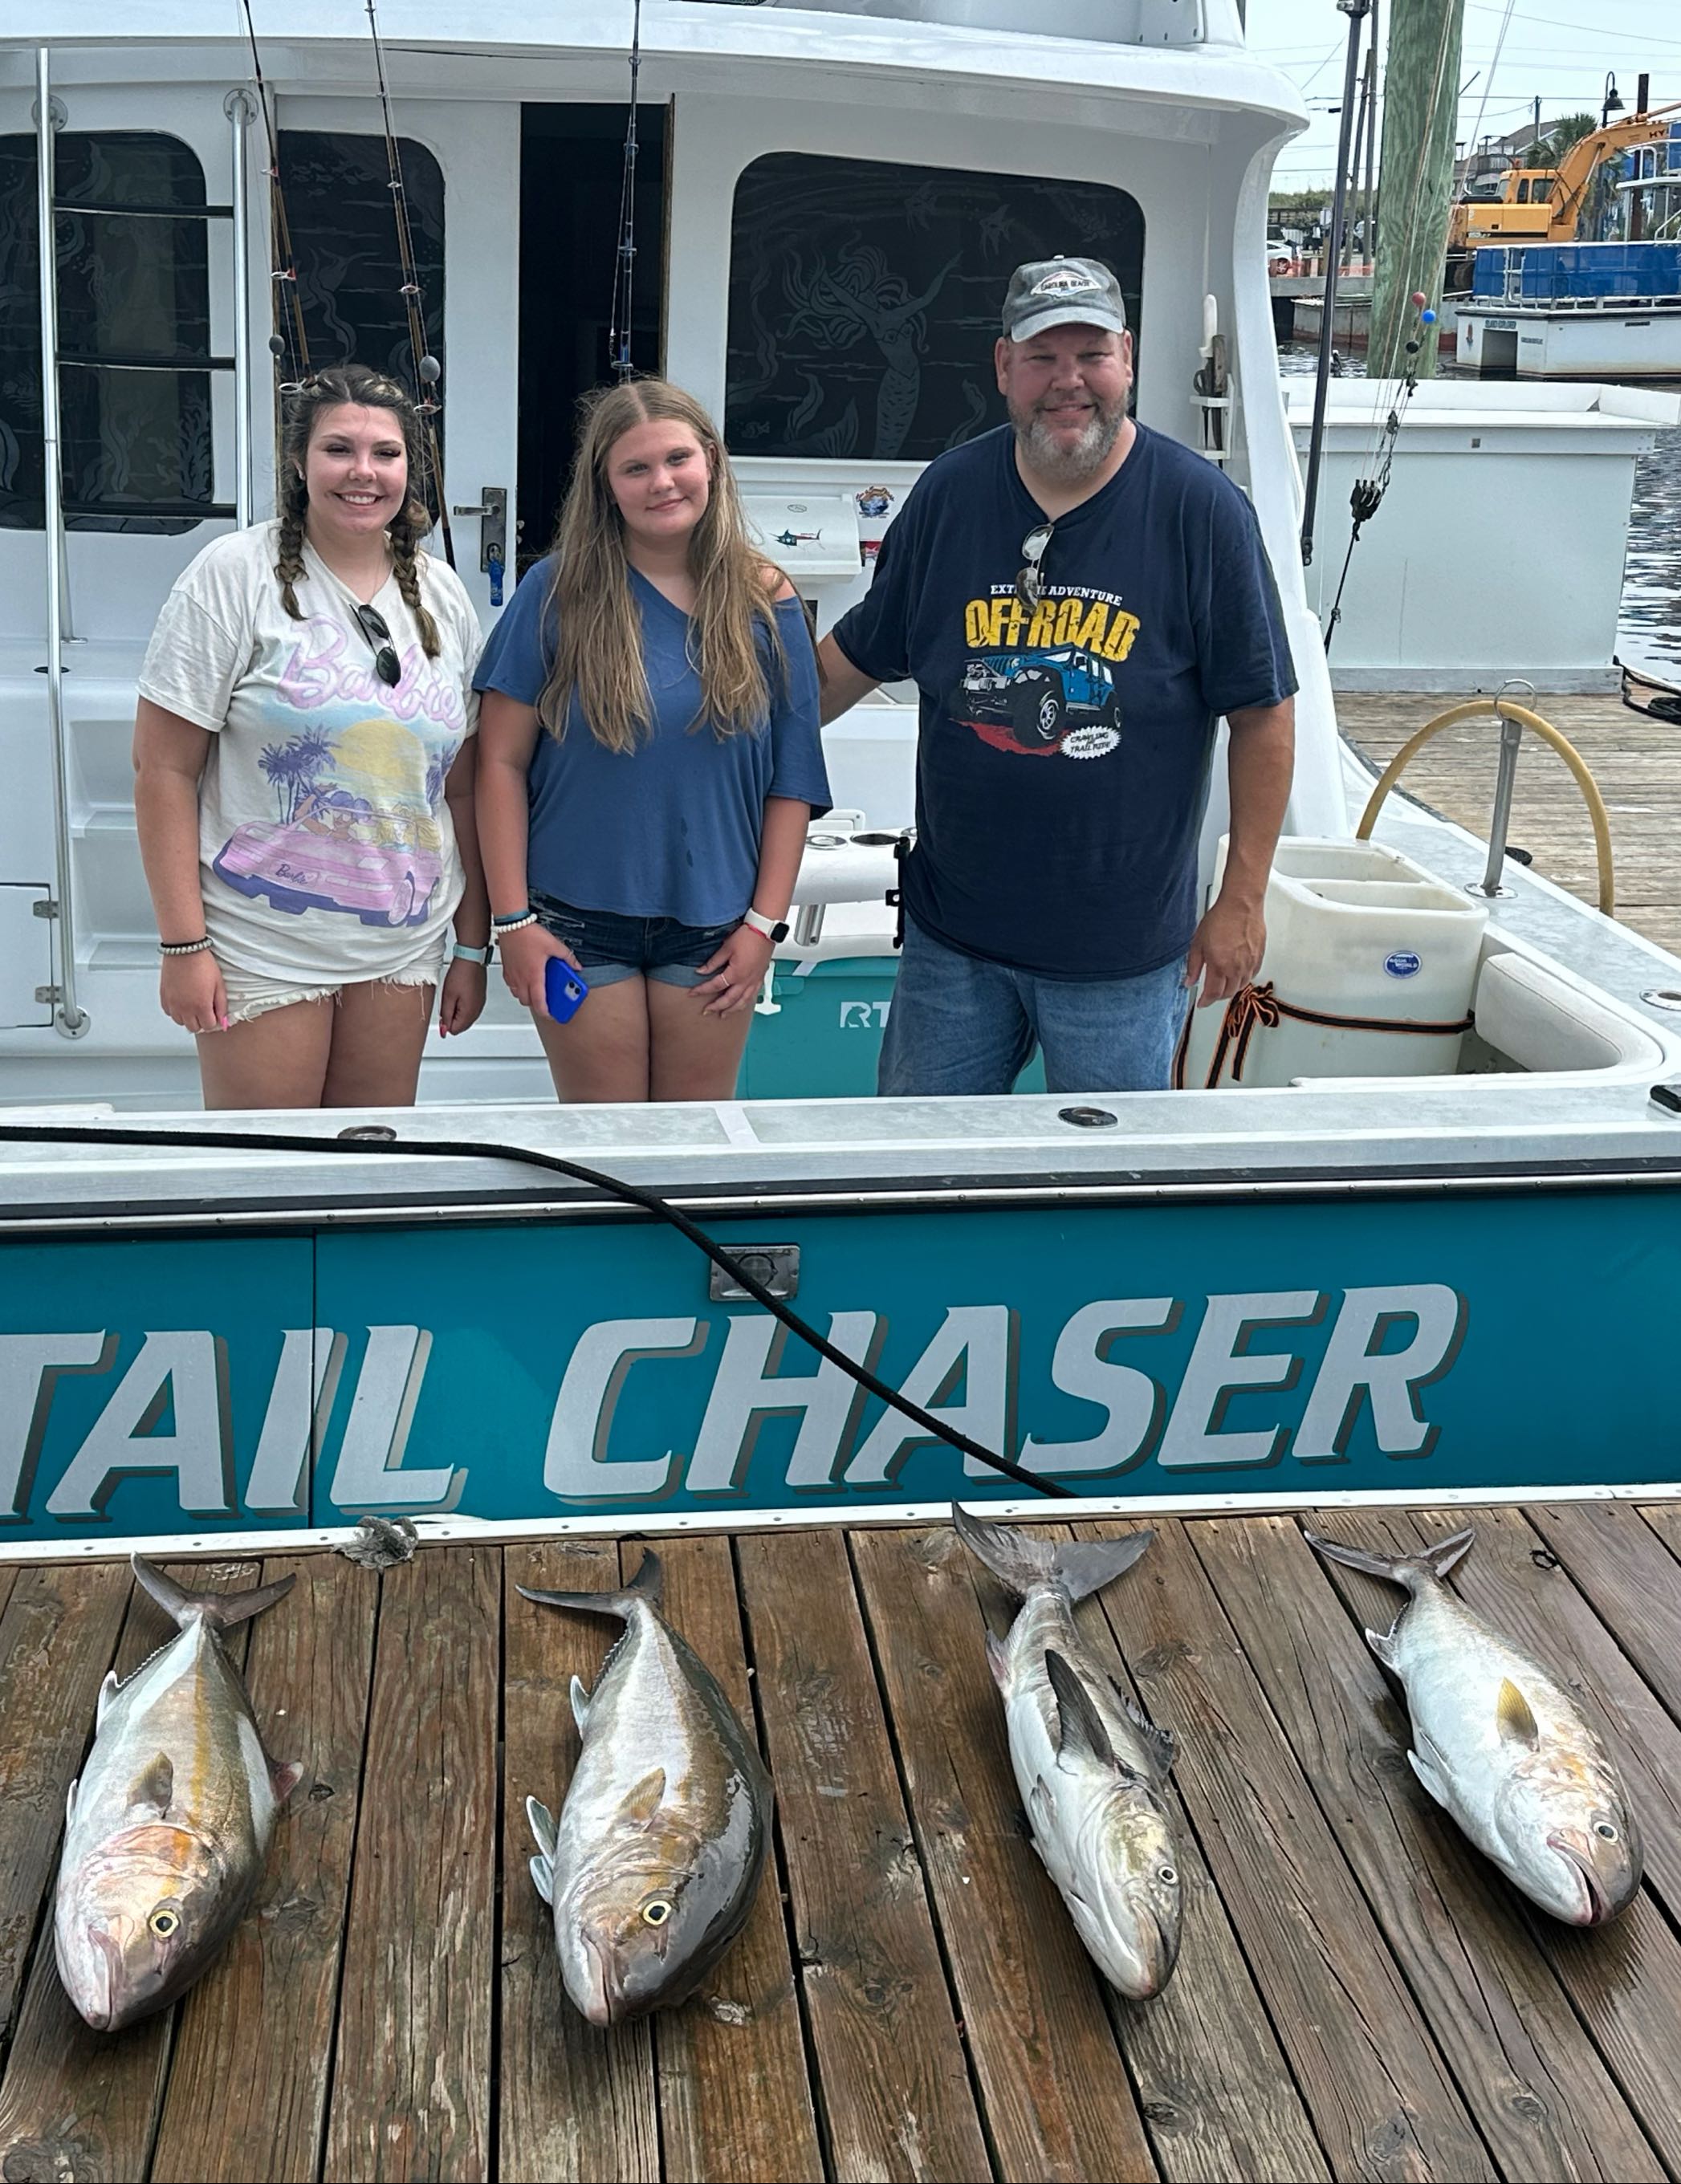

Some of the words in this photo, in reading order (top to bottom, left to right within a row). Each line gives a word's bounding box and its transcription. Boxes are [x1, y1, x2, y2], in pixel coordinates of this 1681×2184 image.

[990, 584, 1048, 595] EXTE
[1048, 584, 1123, 606] ADVENTURE
[275, 863, 308, 885] Barbie
[0, 1324, 459, 1517] TAIL
[543, 1284, 1463, 1499] CHASER
